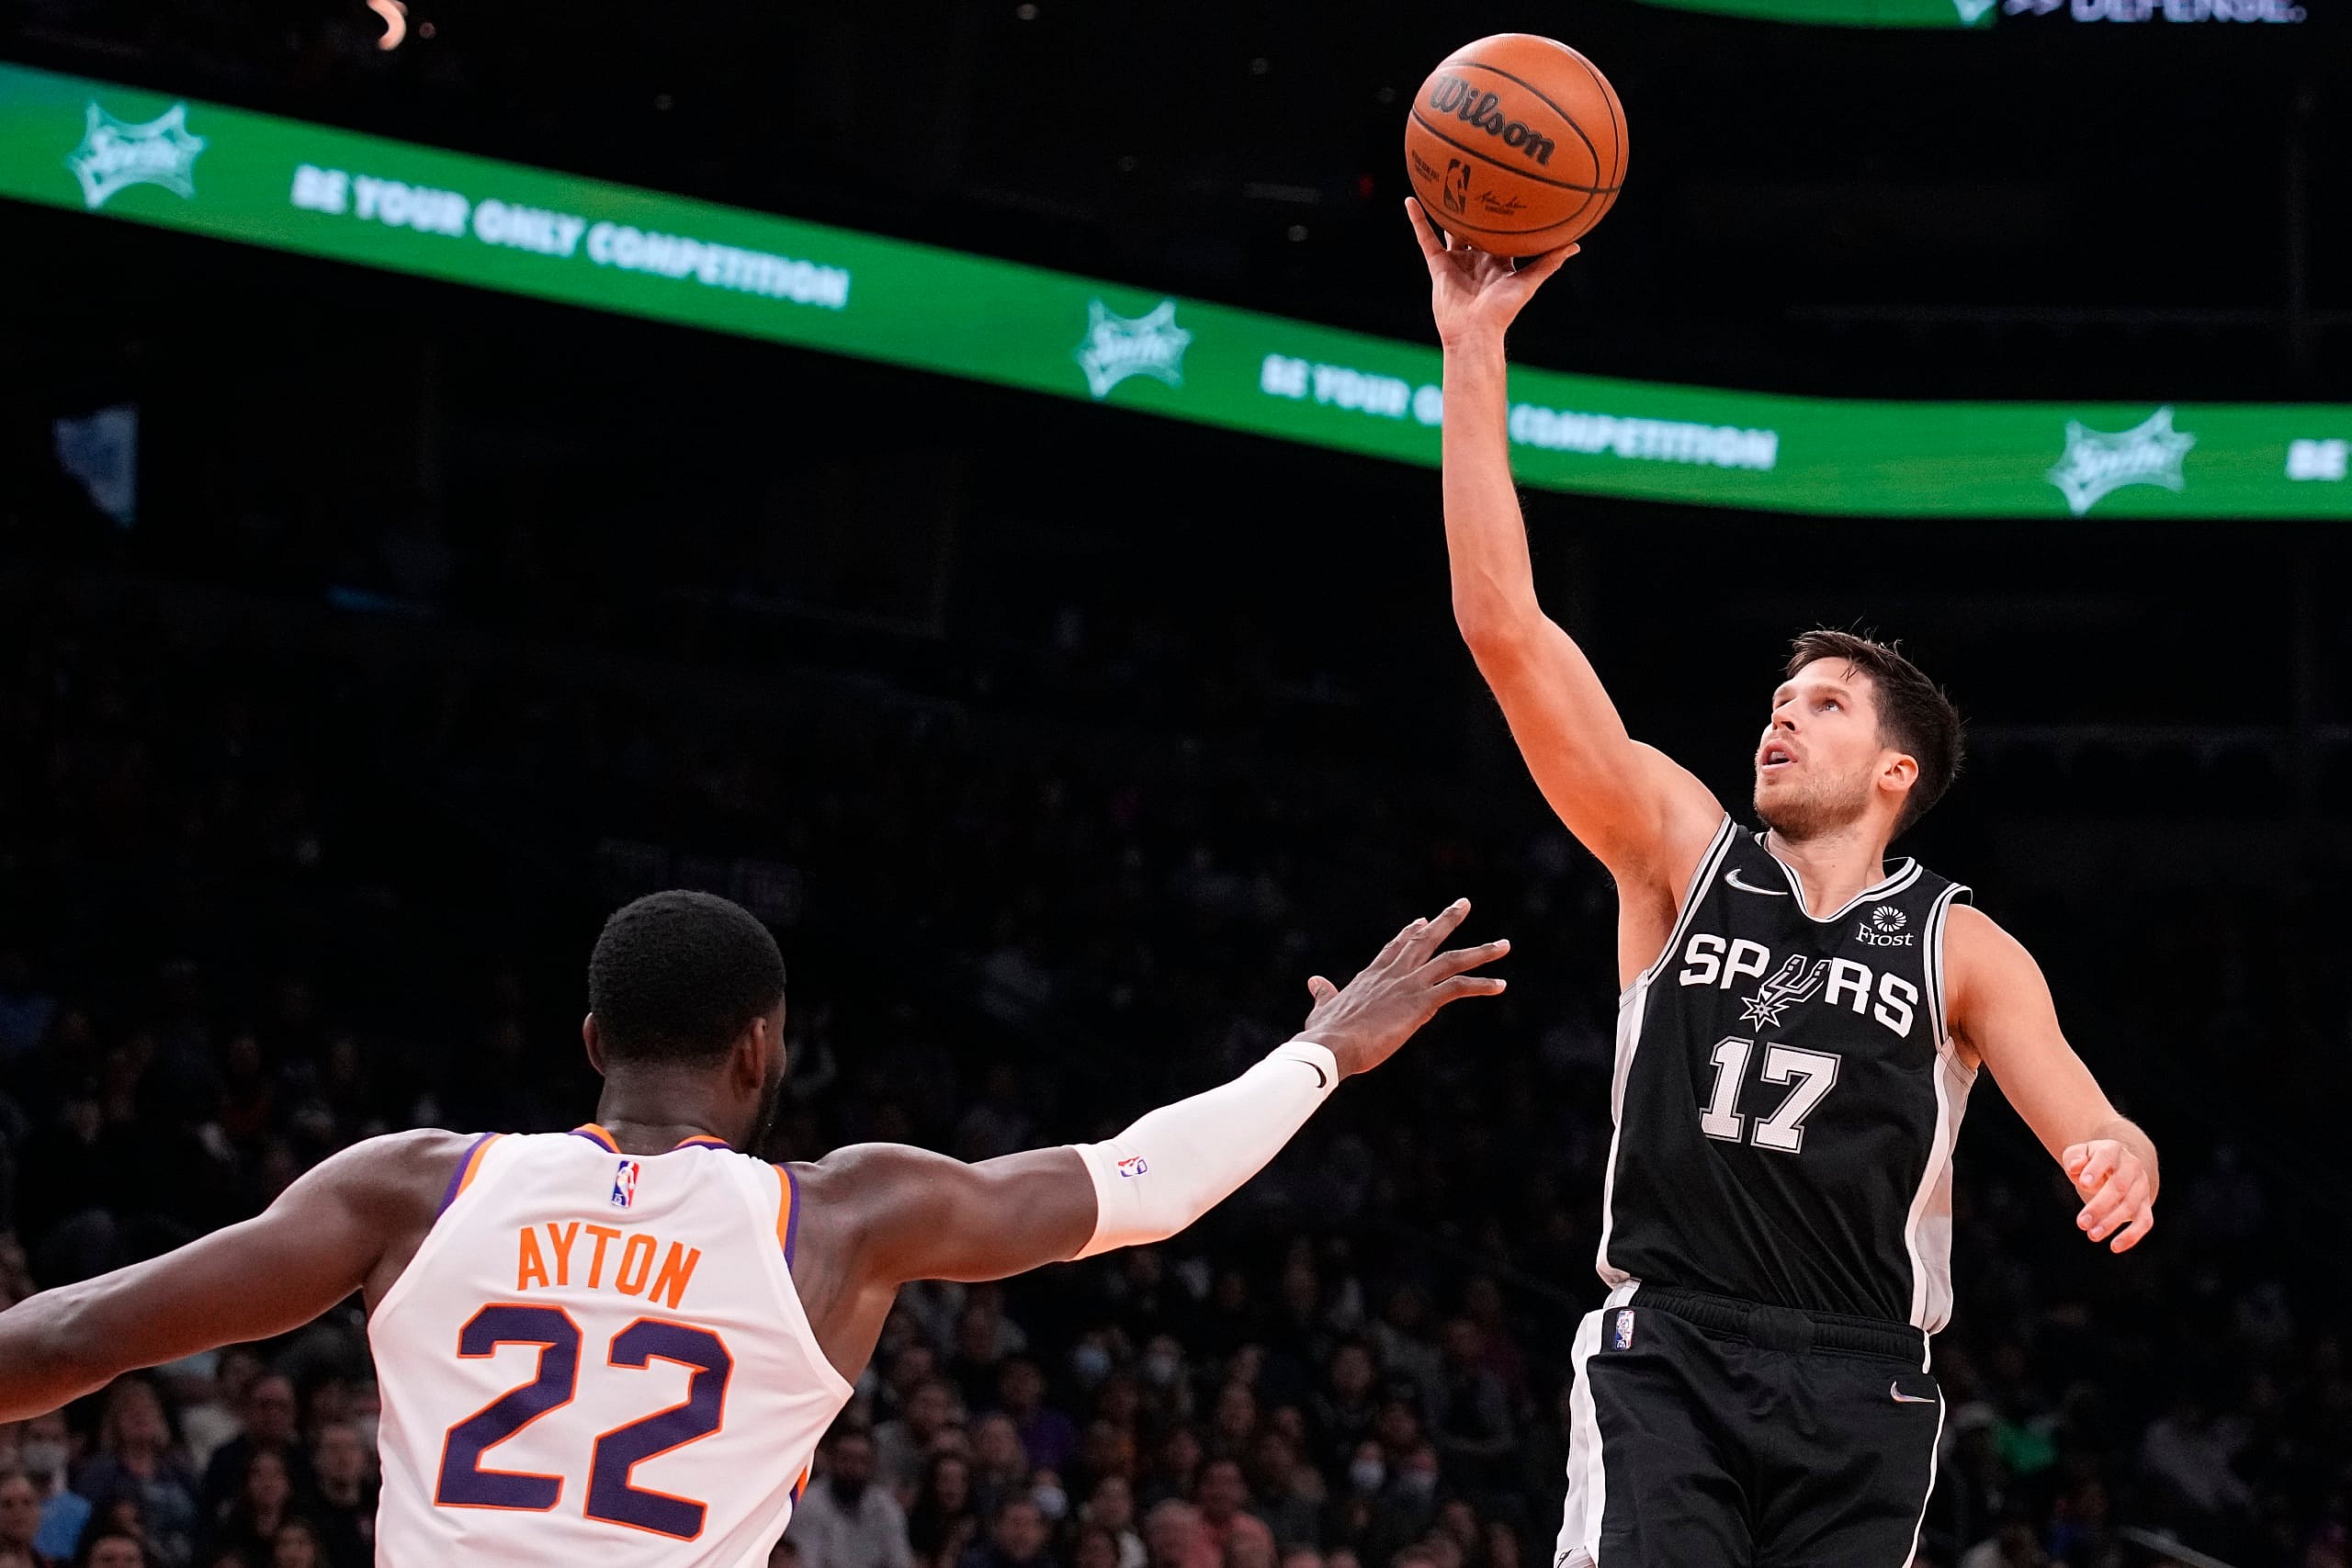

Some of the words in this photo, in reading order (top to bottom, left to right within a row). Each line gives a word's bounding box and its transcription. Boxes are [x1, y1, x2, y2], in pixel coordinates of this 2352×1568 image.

[1430, 74, 1555, 166] Wilson
[290, 164, 350, 215] BE
[353, 174, 470, 238] YOUR
[472, 198, 585, 257] ONLY
[587, 221, 850, 310] COMPETITION
[1261, 354, 1309, 399] BE
[1313, 363, 1411, 419] YOUR
[1510, 402, 1779, 470] COMPETITION
[1856, 922, 1915, 946] Frost
[1679, 933, 1919, 1038] SPURS
[1700, 1035, 1841, 1154] 17
[517, 1222, 701, 1310] AYTON
[434, 1303, 735, 1542] 22
